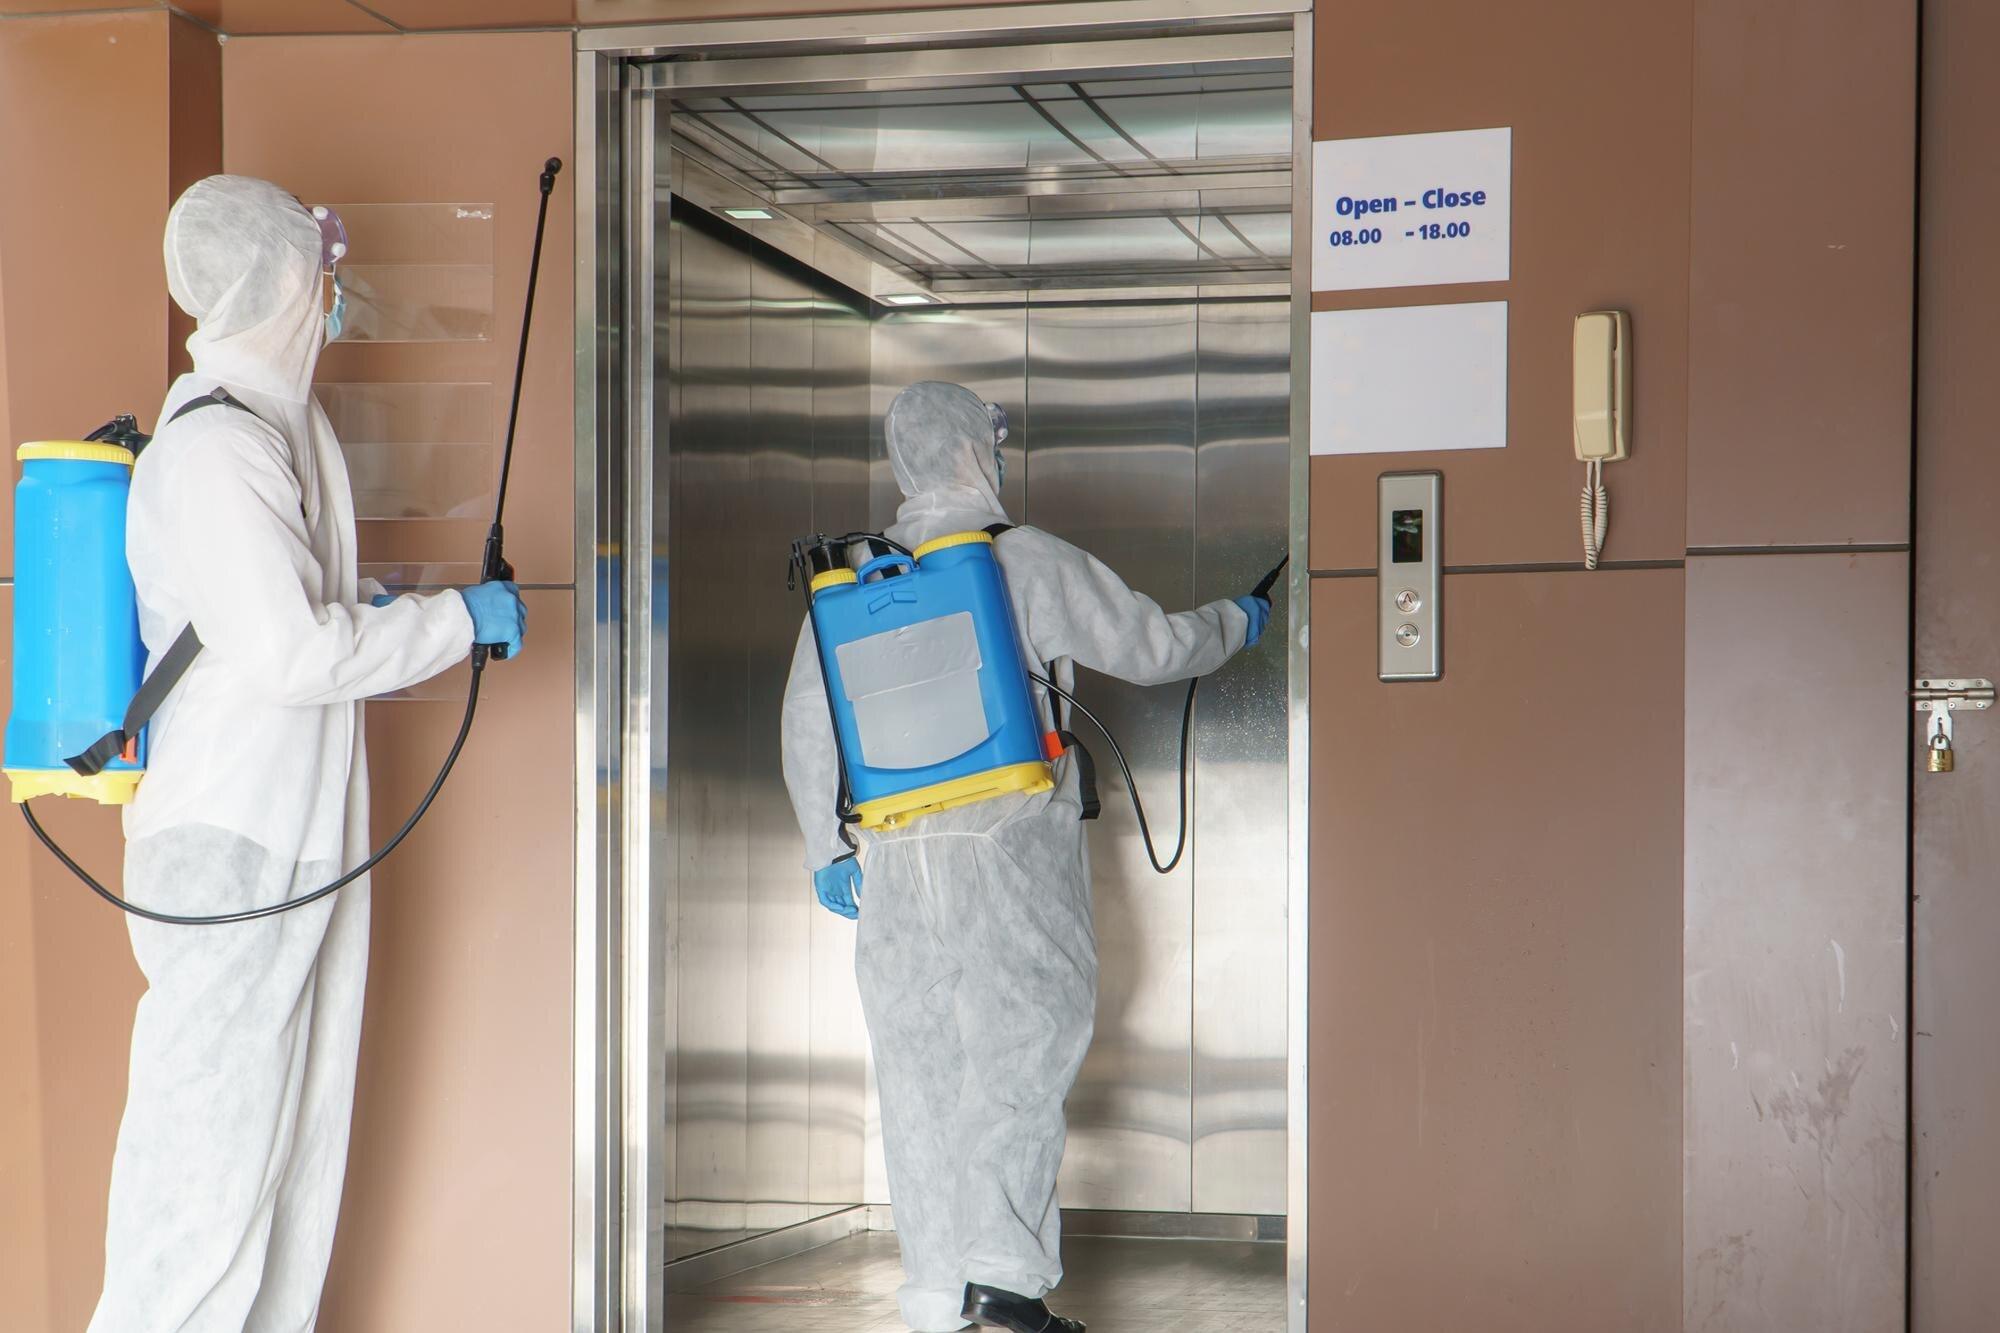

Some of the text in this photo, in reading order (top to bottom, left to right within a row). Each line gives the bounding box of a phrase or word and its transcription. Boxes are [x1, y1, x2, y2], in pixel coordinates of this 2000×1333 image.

[1336, 197, 1397, 219] Open
[1422, 188, 1486, 209] Close
[1330, 228, 1382, 246] 08.00
